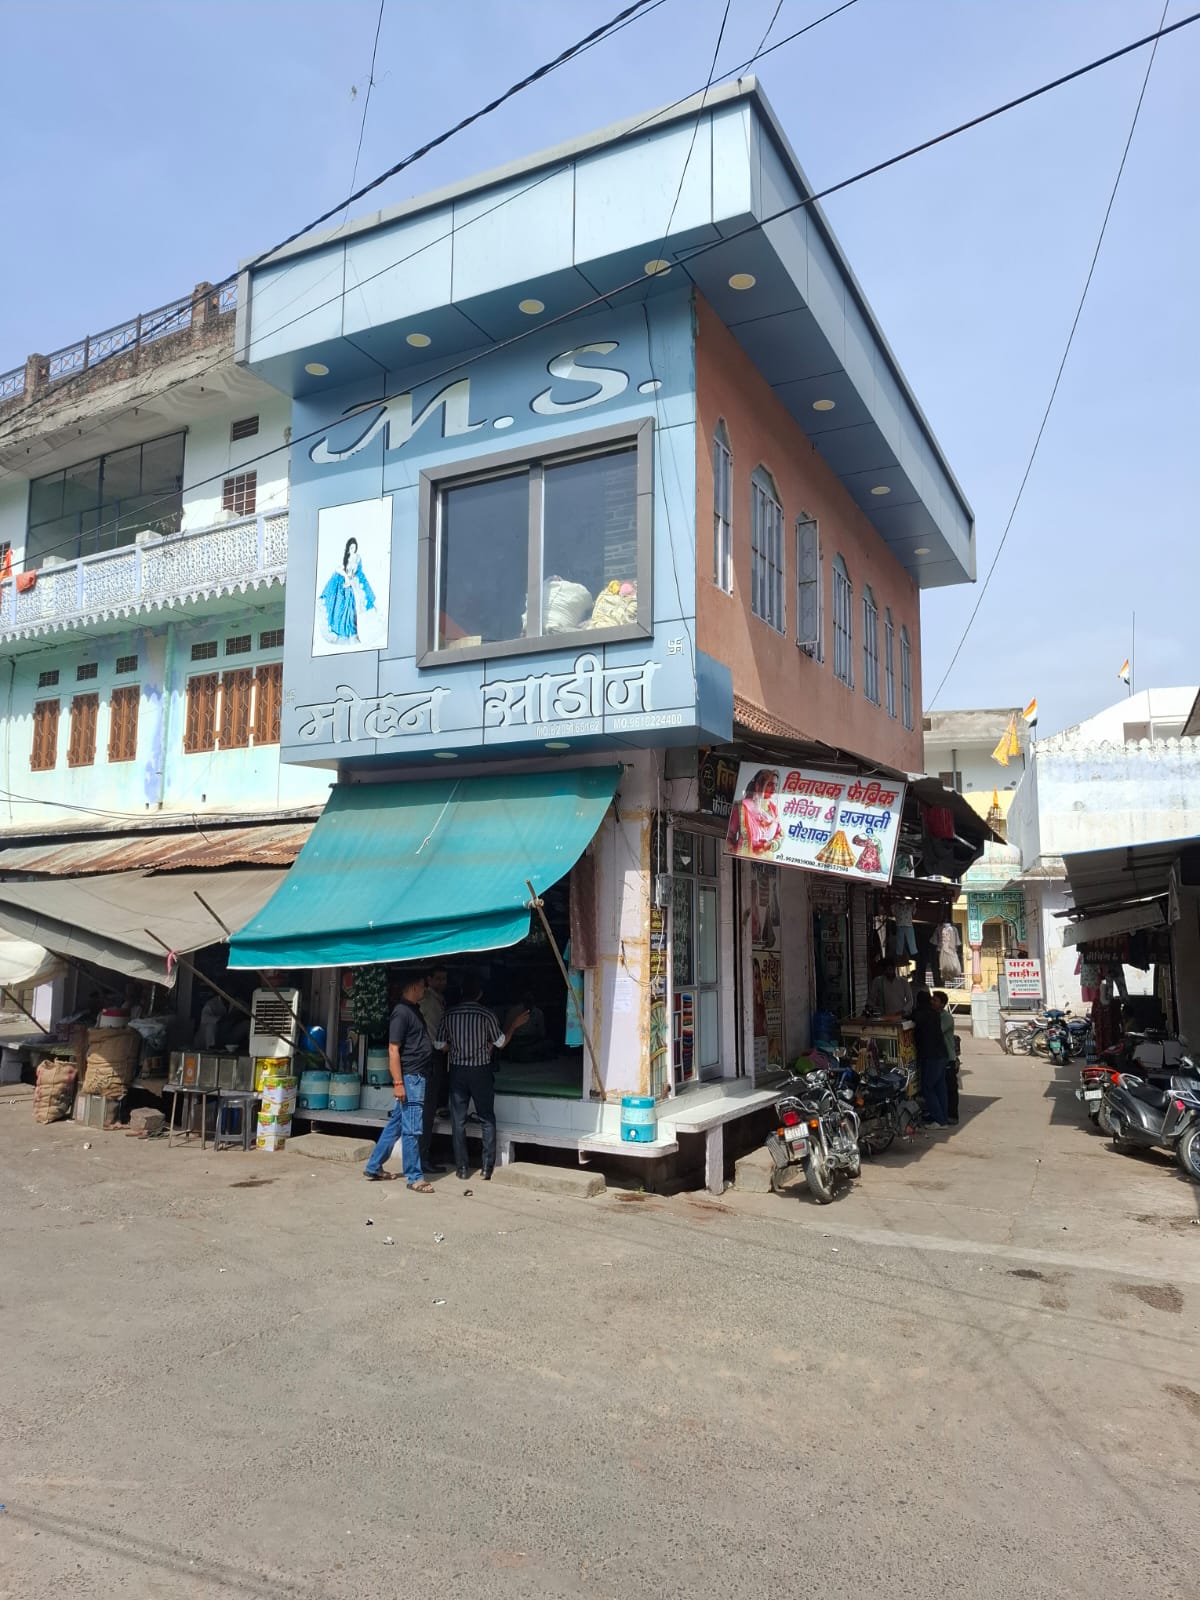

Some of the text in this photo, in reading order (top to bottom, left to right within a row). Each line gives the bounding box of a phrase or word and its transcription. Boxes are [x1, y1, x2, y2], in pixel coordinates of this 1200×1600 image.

[295, 685, 451, 743] मोहन
[782, 771, 846, 798] विनायक
[824, 806, 836, 820] &
[840, 810, 891, 835] राजपूती
